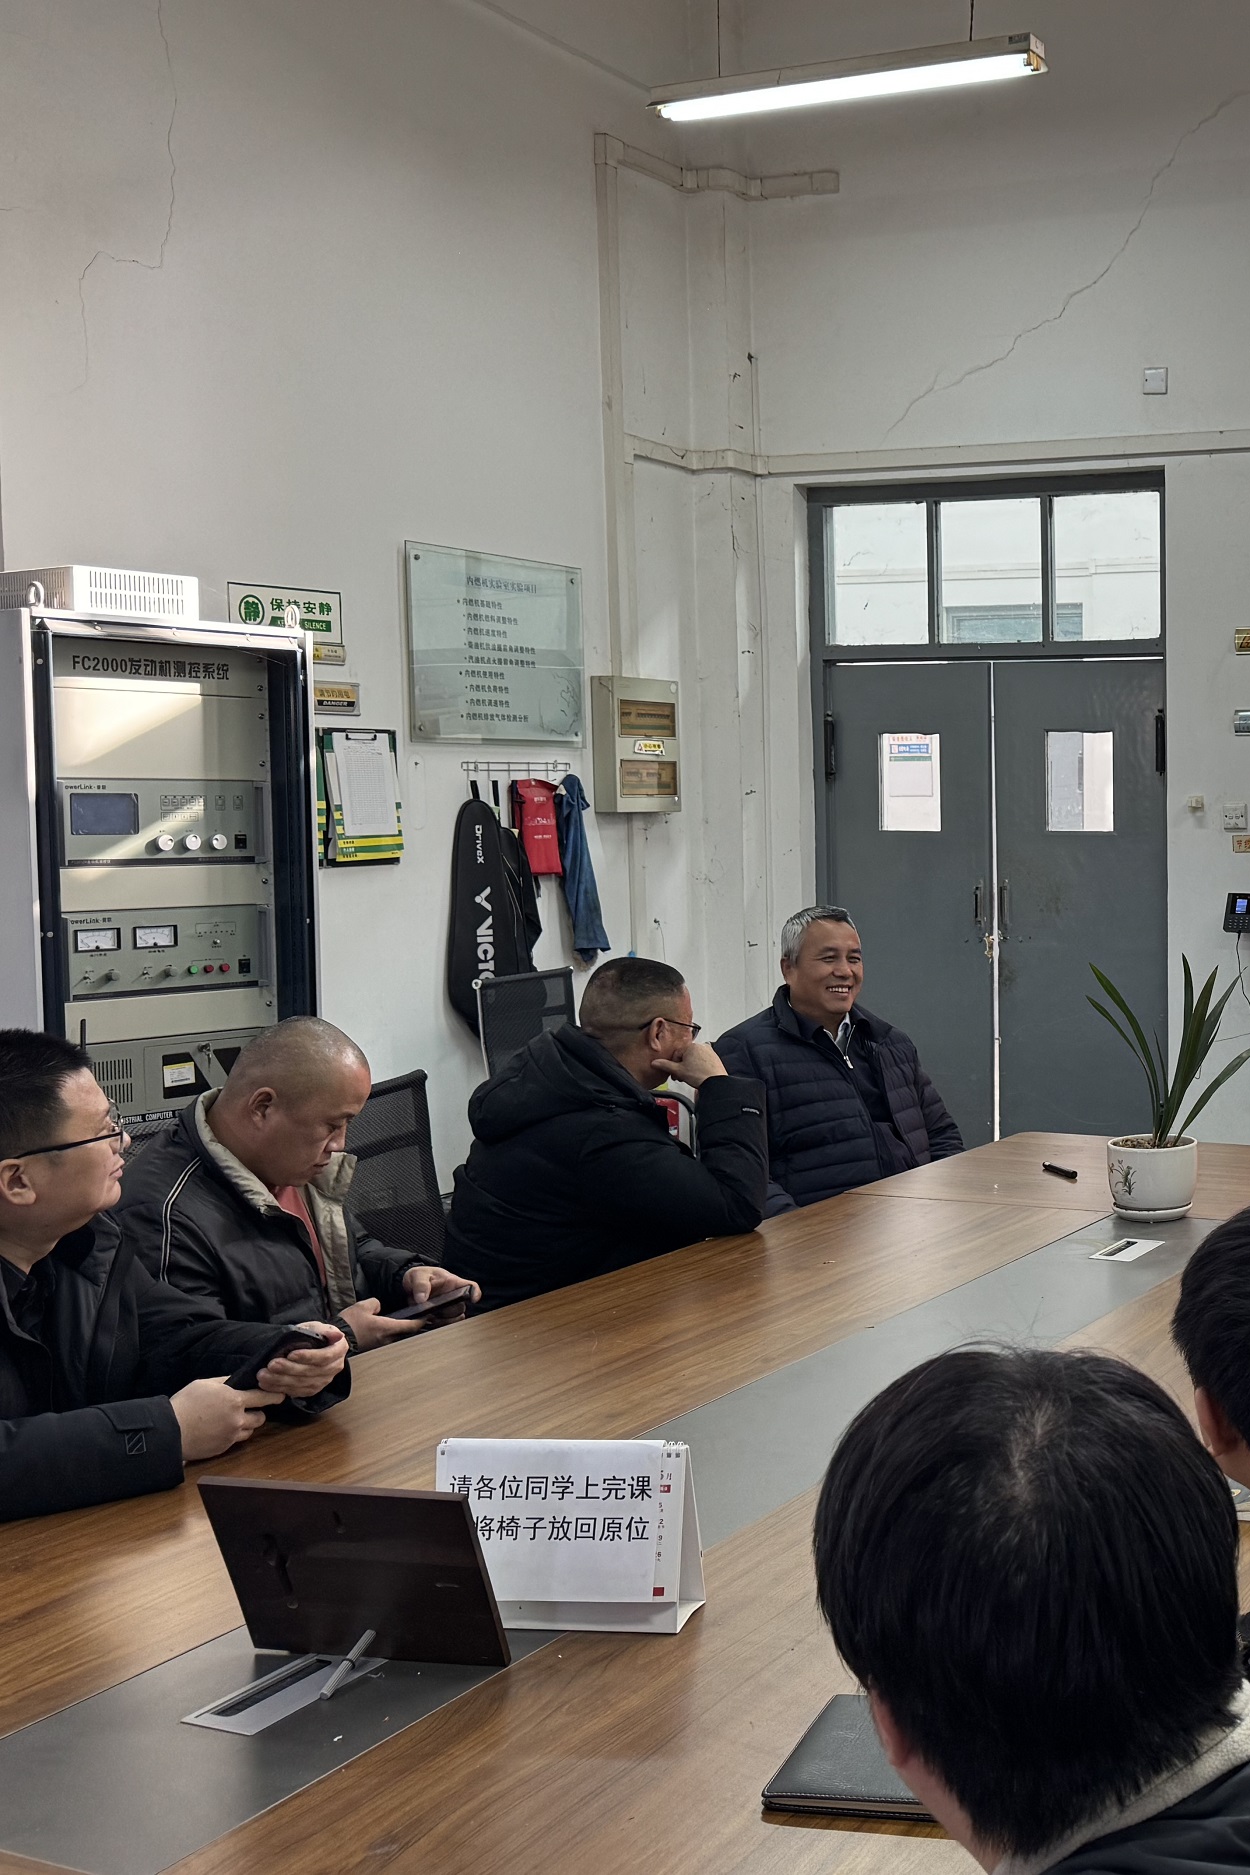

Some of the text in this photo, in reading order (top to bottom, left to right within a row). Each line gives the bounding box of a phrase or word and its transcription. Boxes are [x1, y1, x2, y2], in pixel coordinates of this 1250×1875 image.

[304, 621, 327, 631] SILENCE
[72, 654, 230, 681] FC2000发动机测控系统
[476, 915, 496, 980] VICT
[145, 1110, 173, 1121] COMPUTER
[449, 1474, 653, 1501] 请各位同学上完课
[475, 1515, 650, 1543] 将椅子放回原位
